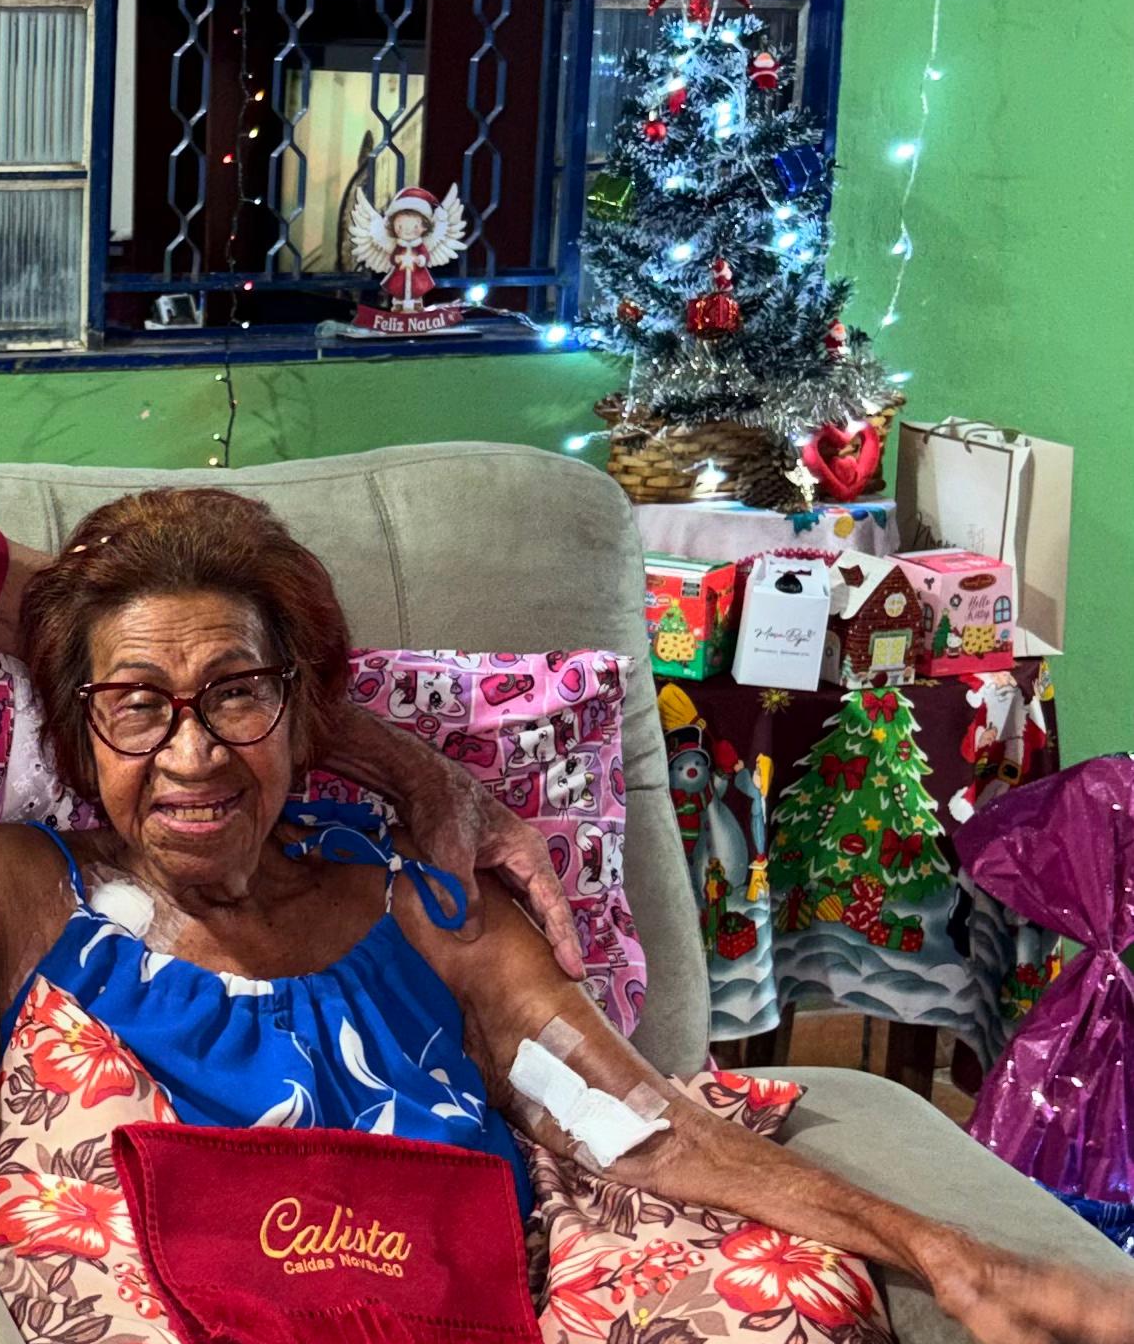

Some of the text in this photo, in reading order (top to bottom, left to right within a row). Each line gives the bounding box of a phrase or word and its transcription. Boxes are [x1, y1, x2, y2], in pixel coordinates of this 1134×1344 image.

[373, 312, 446, 333] Feliz Natal
[259, 1197, 412, 1261] Calista
[283, 1253, 404, 1278] Caldas Novas-GO
